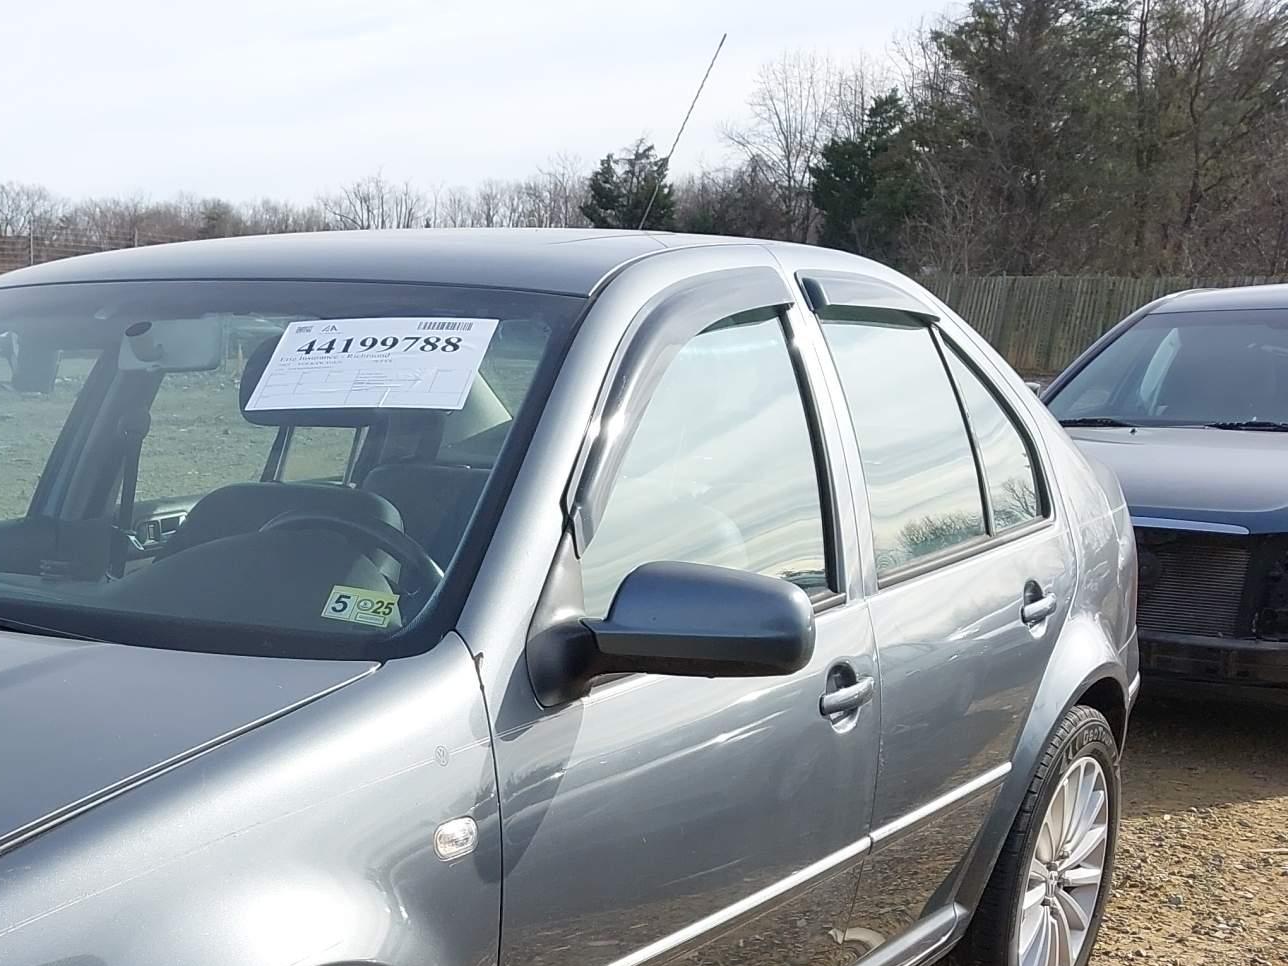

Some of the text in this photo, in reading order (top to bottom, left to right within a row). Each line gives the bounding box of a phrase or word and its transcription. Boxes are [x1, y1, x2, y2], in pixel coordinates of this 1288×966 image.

[296, 335, 462, 355] 44199788
[331, 594, 395, 616] 5 25
